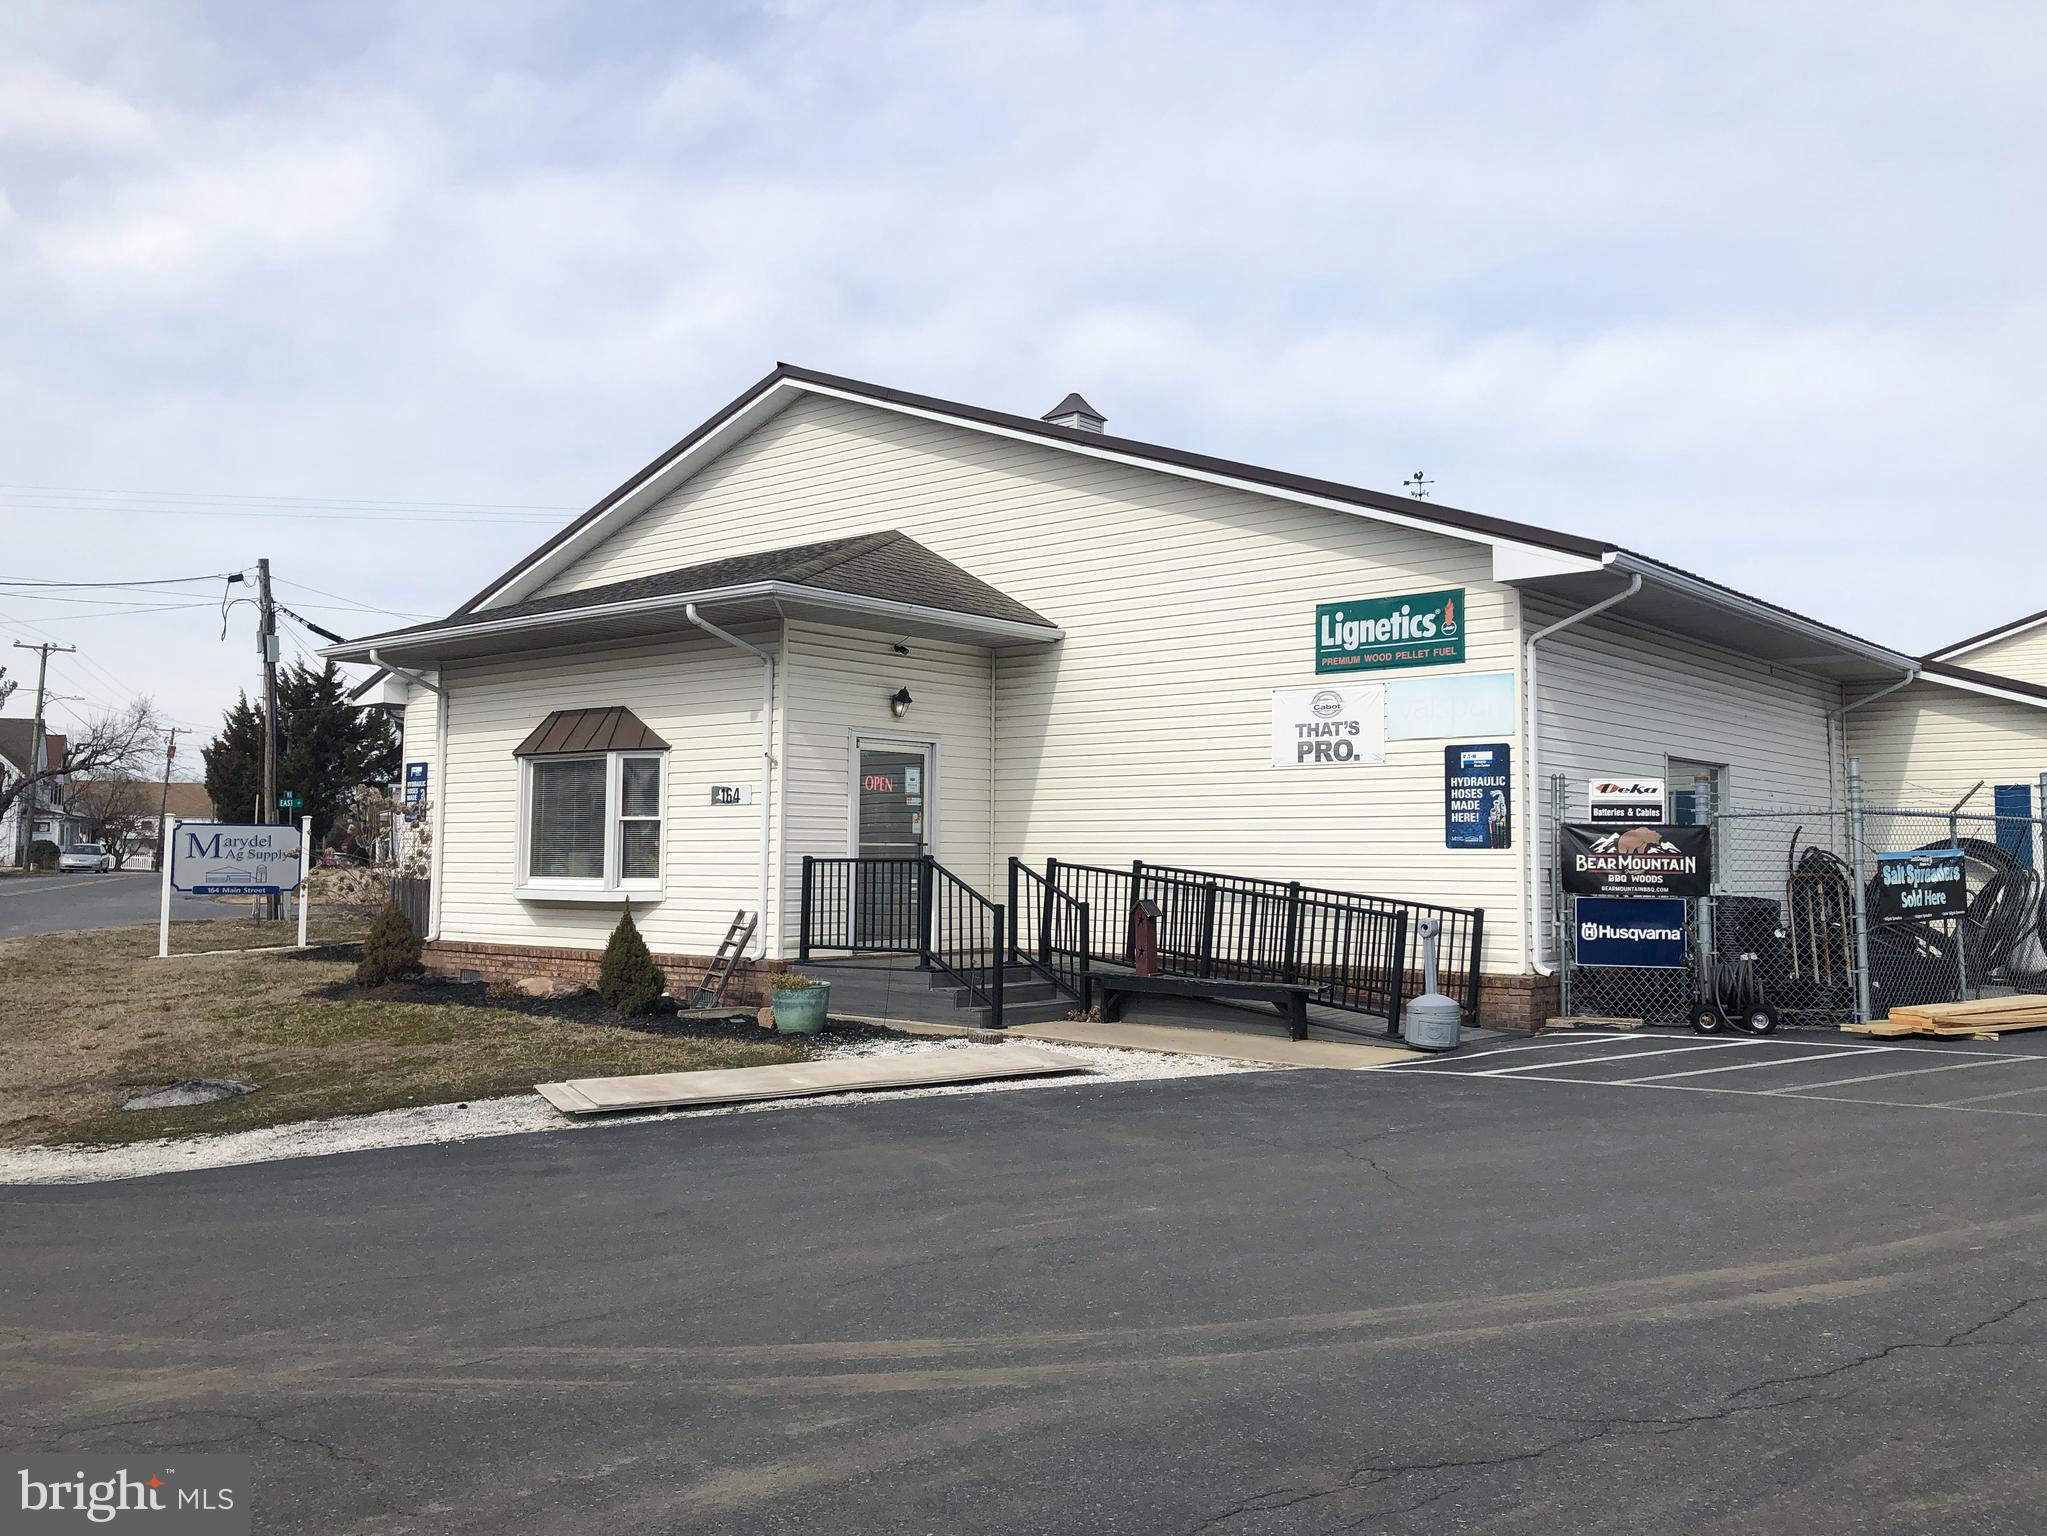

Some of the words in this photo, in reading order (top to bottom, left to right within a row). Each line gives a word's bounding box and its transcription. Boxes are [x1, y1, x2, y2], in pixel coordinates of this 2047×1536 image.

[1321, 604, 1437, 651] Lignetics
[1321, 655, 1360, 666] PREMIUM
[1364, 653, 1392, 663] WOOD
[1396, 649, 1429, 660] PELLET
[1433, 647, 1457, 657] FUEL
[1295, 720, 1360, 738] THAT'S
[1297, 739, 1360, 763] PRO.
[865, 775, 893, 792] OPEN
[1450, 776, 1506, 787] HYDRAULIC
[1596, 783, 1658, 794] Deka
[721, 787, 741, 803] 164
[1451, 788, 1483, 799] HOSES
[1451, 800, 1480, 810] MADE
[1593, 808, 1625, 817] Batteries
[1627, 808, 1634, 816] &
[1635, 808, 1660, 817] Cables
[1451, 812, 1479, 822] HERE!
[184, 833, 272, 859] Marydel
[225, 849, 244, 861] Ag
[247, 849, 289, 862] Supply
[1608, 875, 1627, 883] BBQ
[1631, 875, 1664, 883] WOODS
[1883, 865, 1906, 886] Salt
[1906, 864, 1960, 888] Spreaders
[1601, 885, 1669, 893] BEARMOUNTAINBBQ.COM
[1901, 889, 1923, 908] Sold
[1924, 890, 1947, 906] Here
[1598, 925, 1680, 941] Husqvarna
